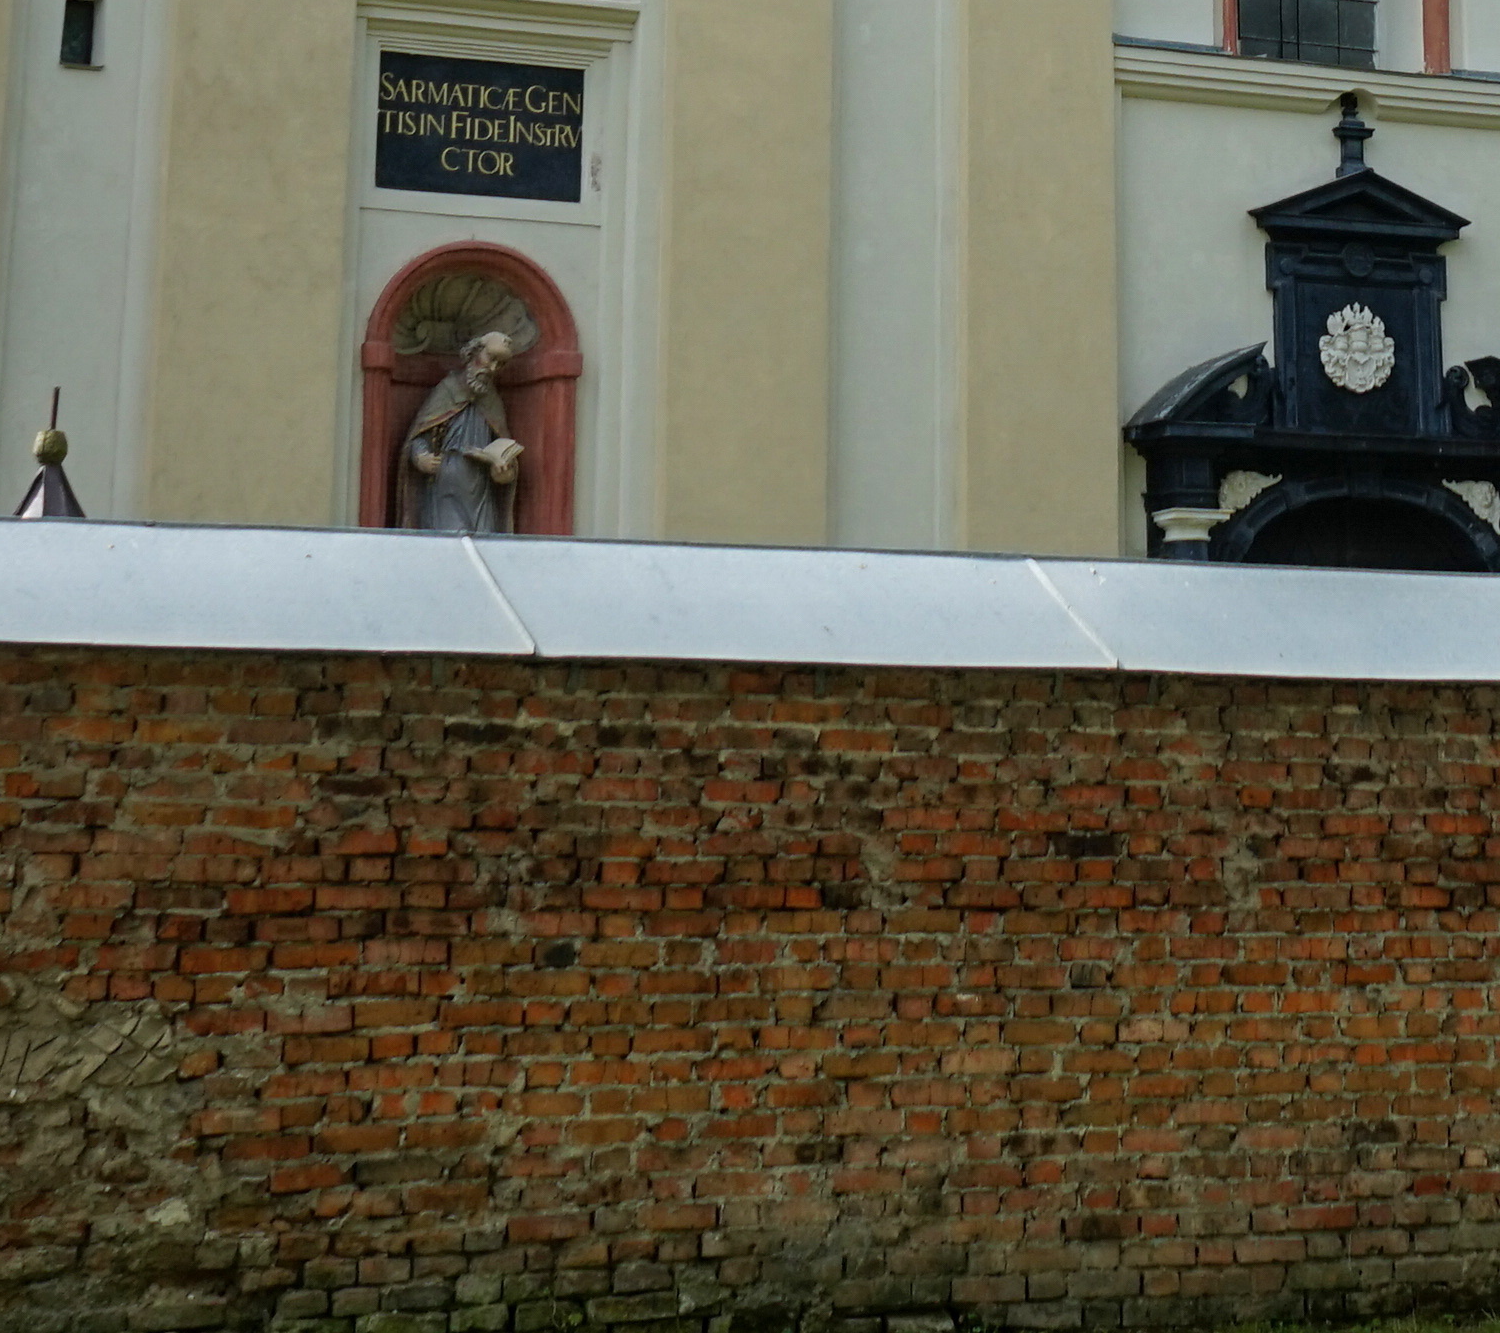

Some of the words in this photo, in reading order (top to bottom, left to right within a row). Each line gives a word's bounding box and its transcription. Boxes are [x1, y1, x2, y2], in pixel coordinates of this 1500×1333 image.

[524, 85, 582, 116] GEN
[378, 109, 416, 135] TIS
[419, 113, 445, 137] IN
[451, 111, 508, 144] FIDE
[440, 146, 516, 178] CTOR
